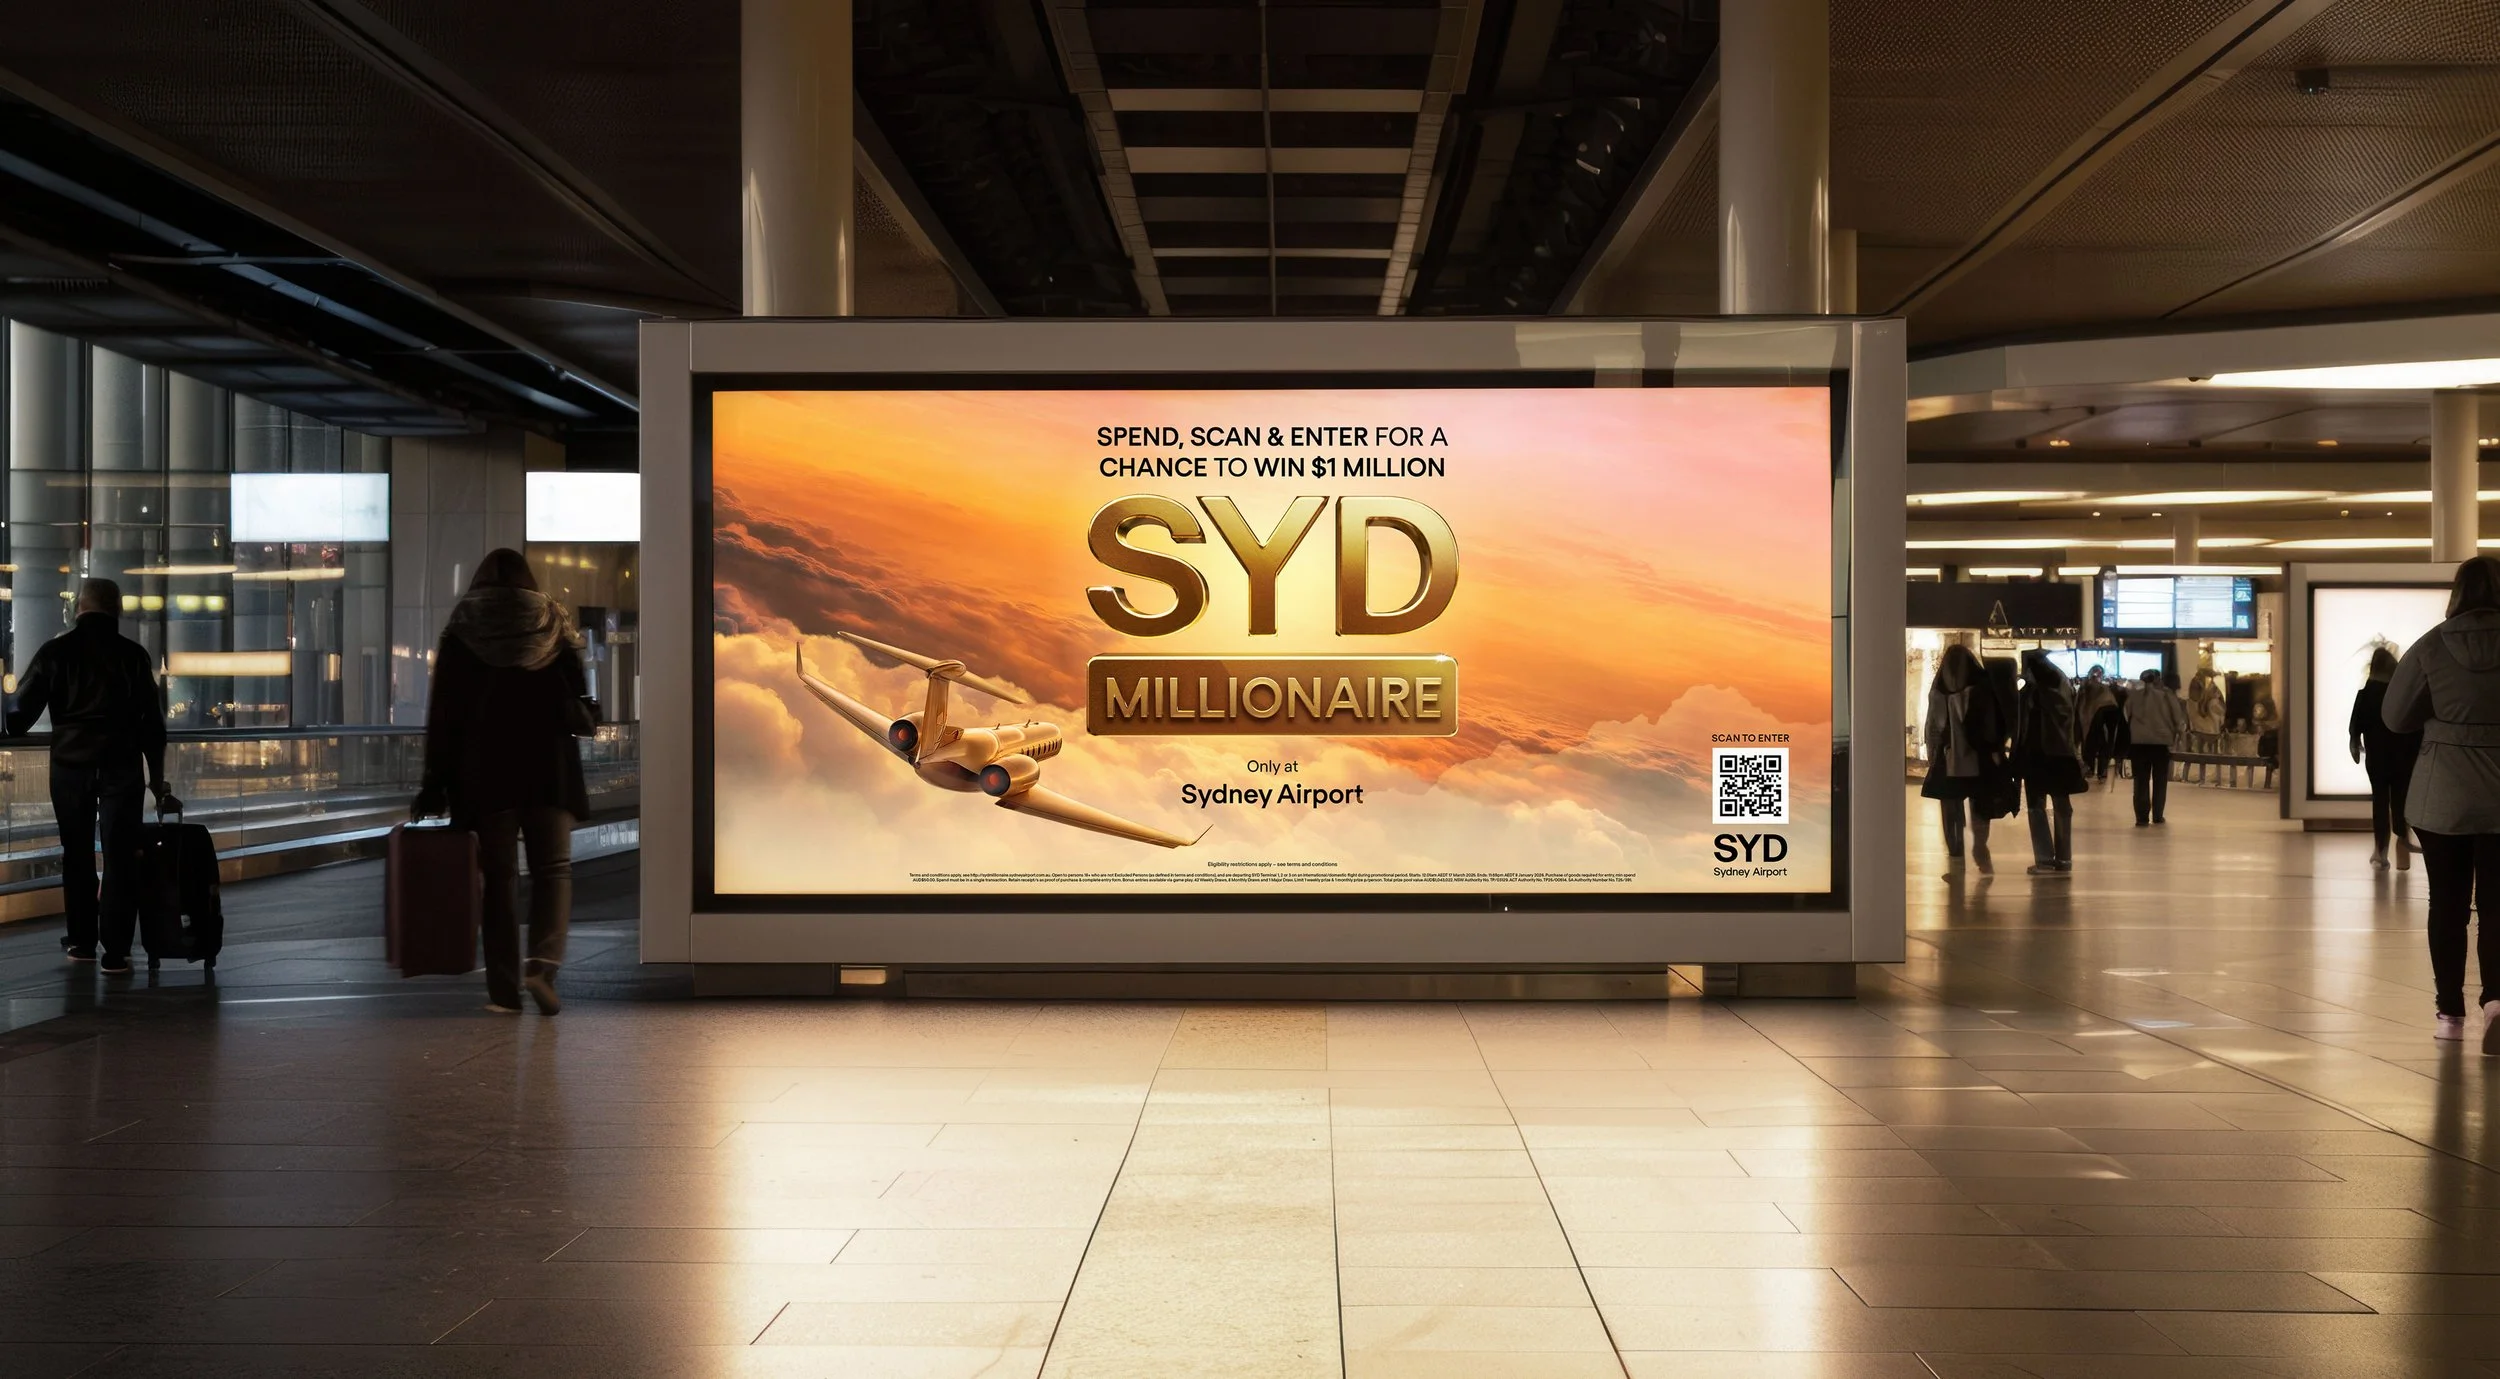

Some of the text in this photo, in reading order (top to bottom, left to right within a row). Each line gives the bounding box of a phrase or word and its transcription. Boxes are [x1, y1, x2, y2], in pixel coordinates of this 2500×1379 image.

[1097, 427, 1448, 449] SPEND, SCAN & ENTER FOR A
[1100, 456, 1444, 479] CHANCE TO WIN $1 MILLION
[1085, 493, 1460, 637] SYD
[1106, 676, 1443, 719] MILLIONAIRE
[1711, 734, 1790, 742] SCAN TO ENTER
[1247, 760, 1298, 775] Only at
[1182, 783, 1363, 809] Sydney Airport
[1713, 834, 1788, 862] SYD
[1714, 867, 1787, 878] Sydney Airport
